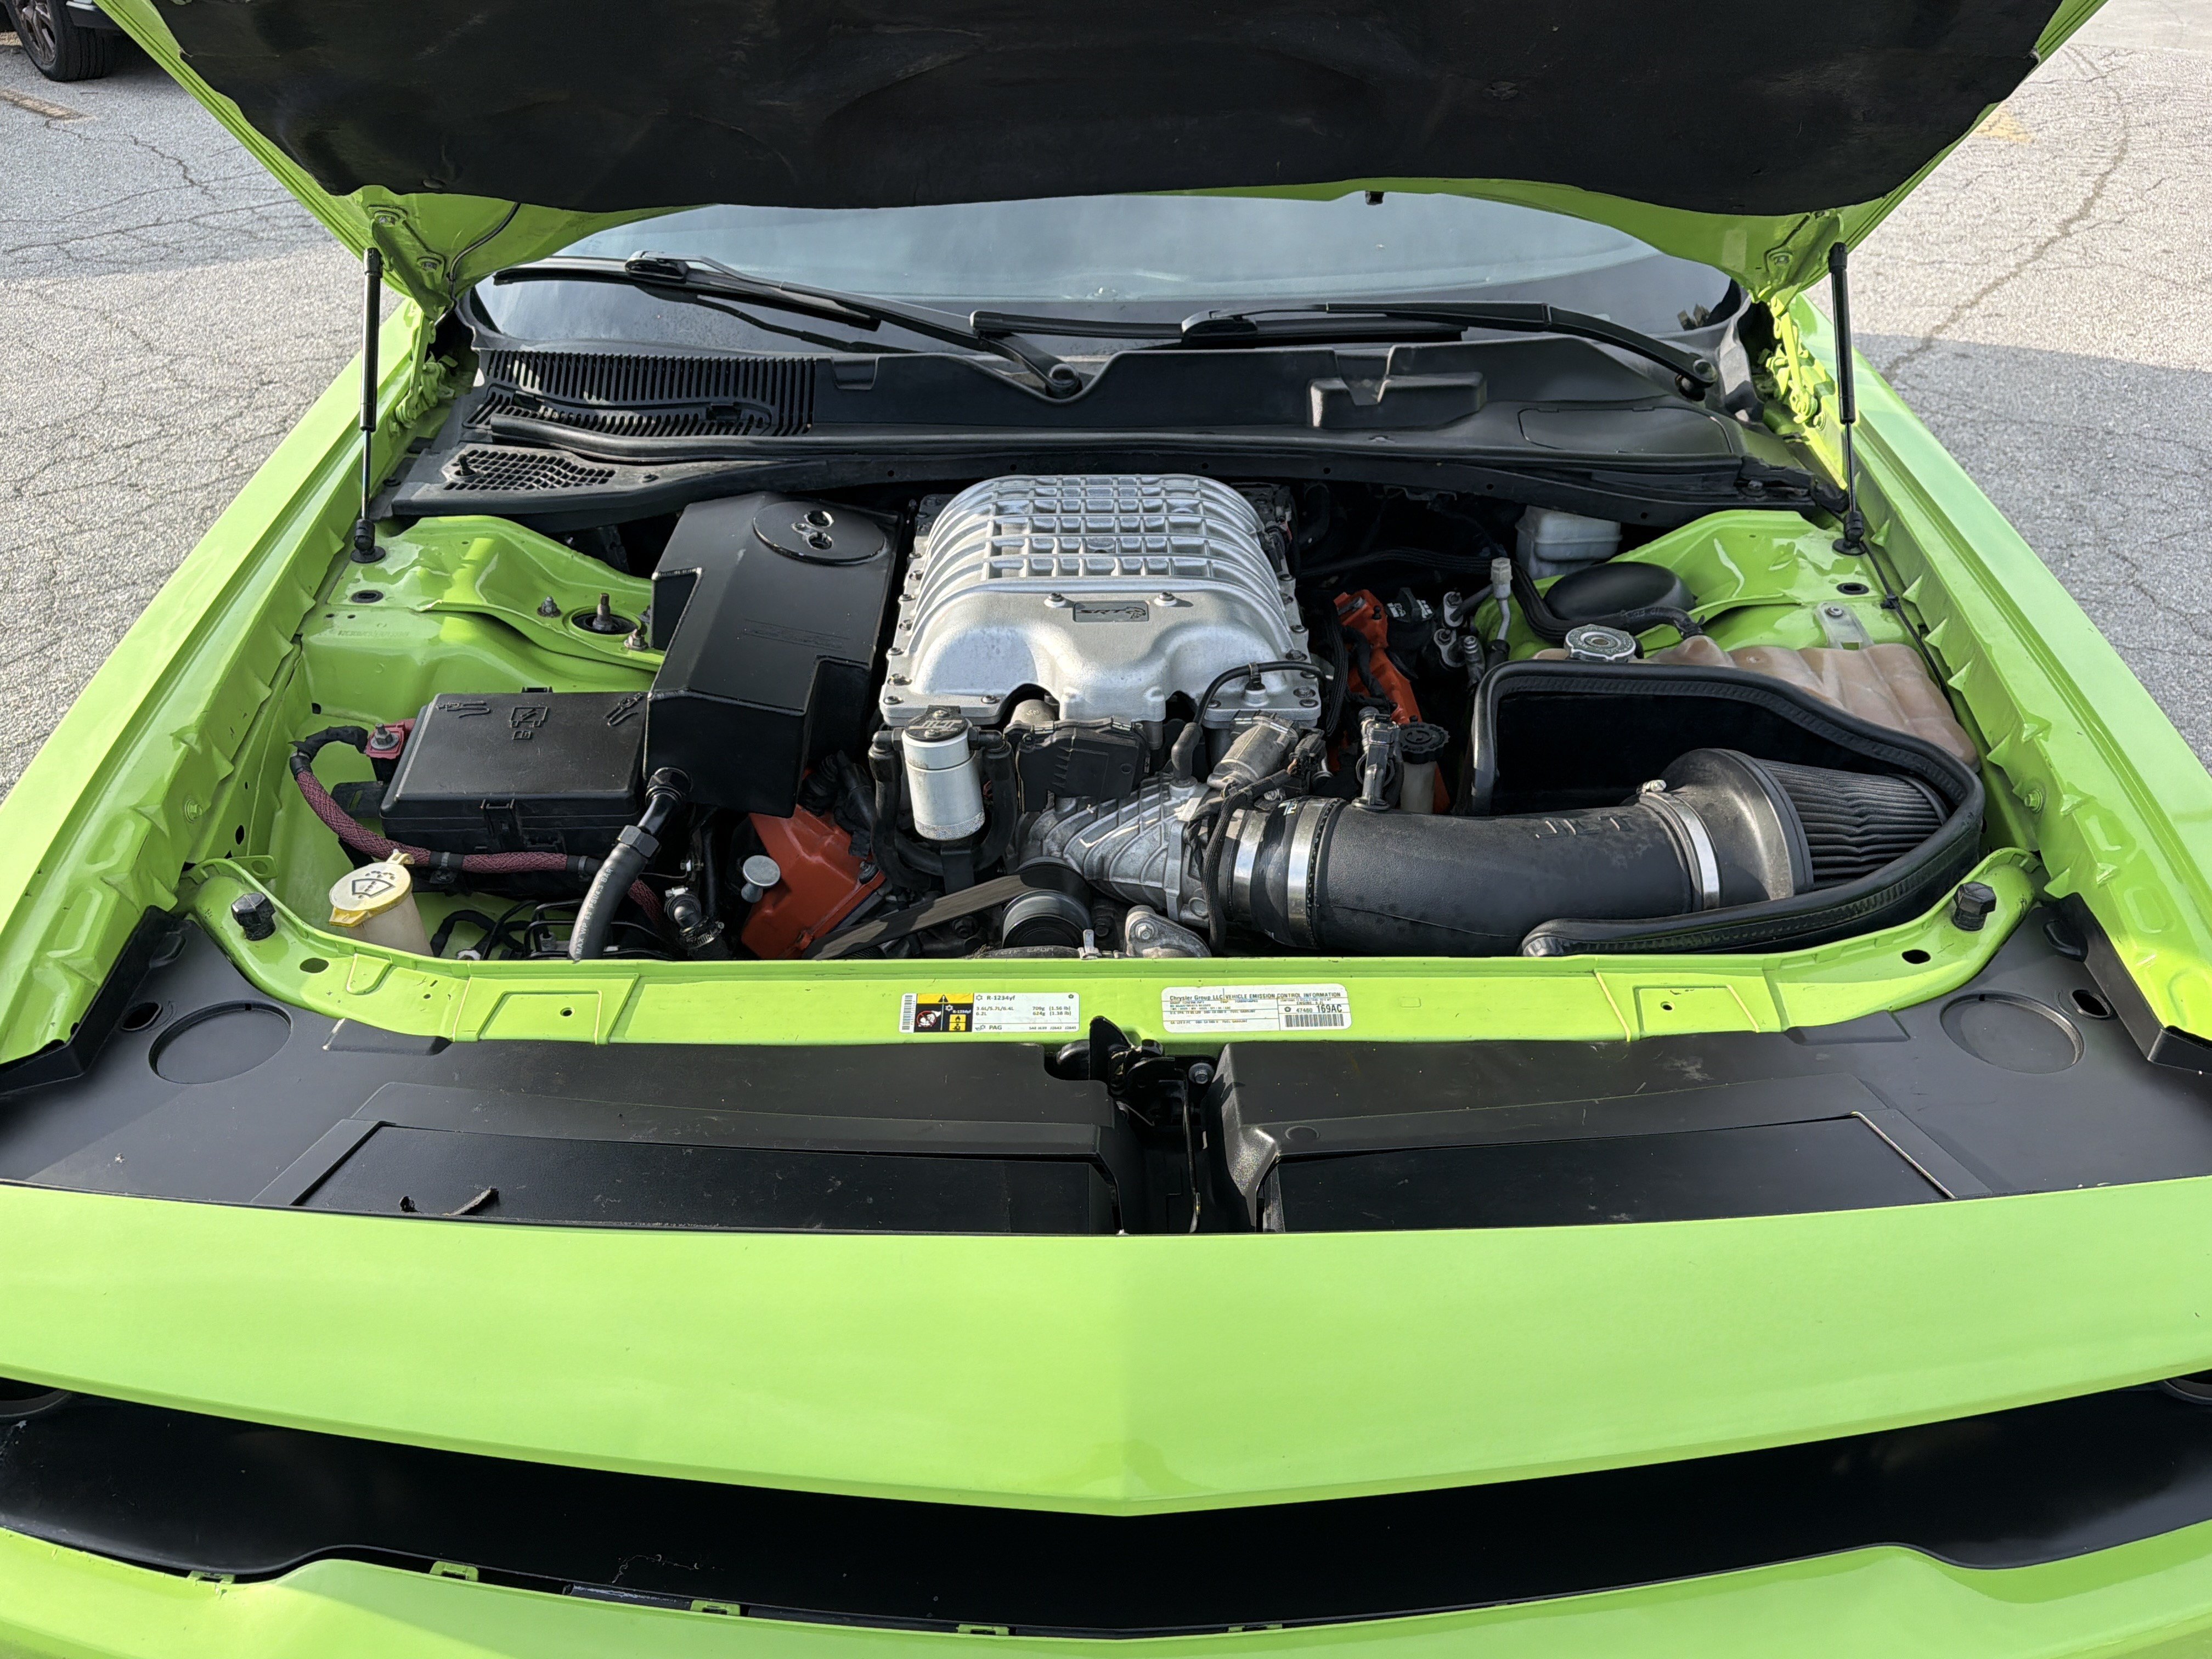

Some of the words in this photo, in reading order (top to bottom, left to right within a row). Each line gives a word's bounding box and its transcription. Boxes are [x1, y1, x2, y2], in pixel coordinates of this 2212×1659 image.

[1536, 815, 1632, 839] JLT
[575, 937, 585, 955] MAX
[580, 922, 588, 934] WP
[584, 911, 592, 921] 63
[600, 868, 614, 883] BAR
[1317, 1004, 1342, 1013] 169AC
